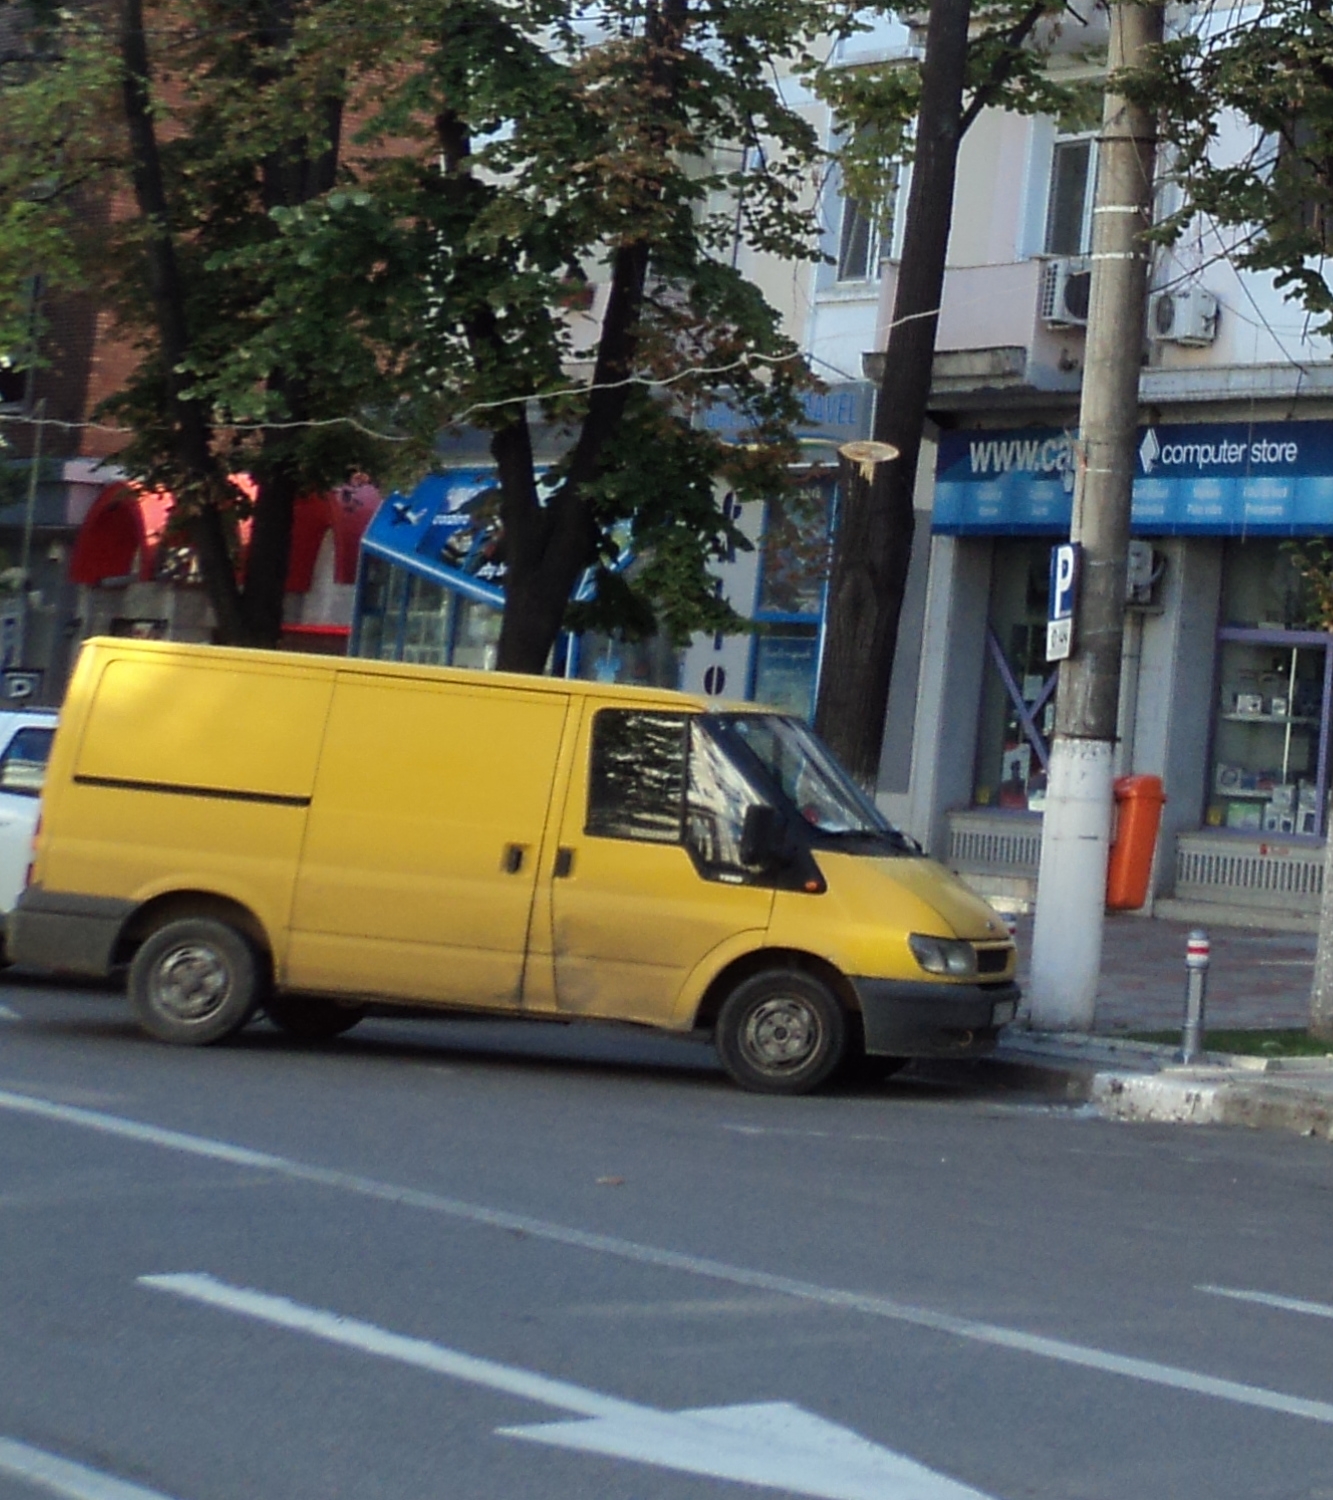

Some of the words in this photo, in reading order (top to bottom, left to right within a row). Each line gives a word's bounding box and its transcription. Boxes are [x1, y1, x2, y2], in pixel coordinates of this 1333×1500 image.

[969, 438, 1073, 473] www.ca
[1161, 438, 1247, 470] computer
[1250, 438, 1298, 464] store
[1054, 545, 1075, 619] P
